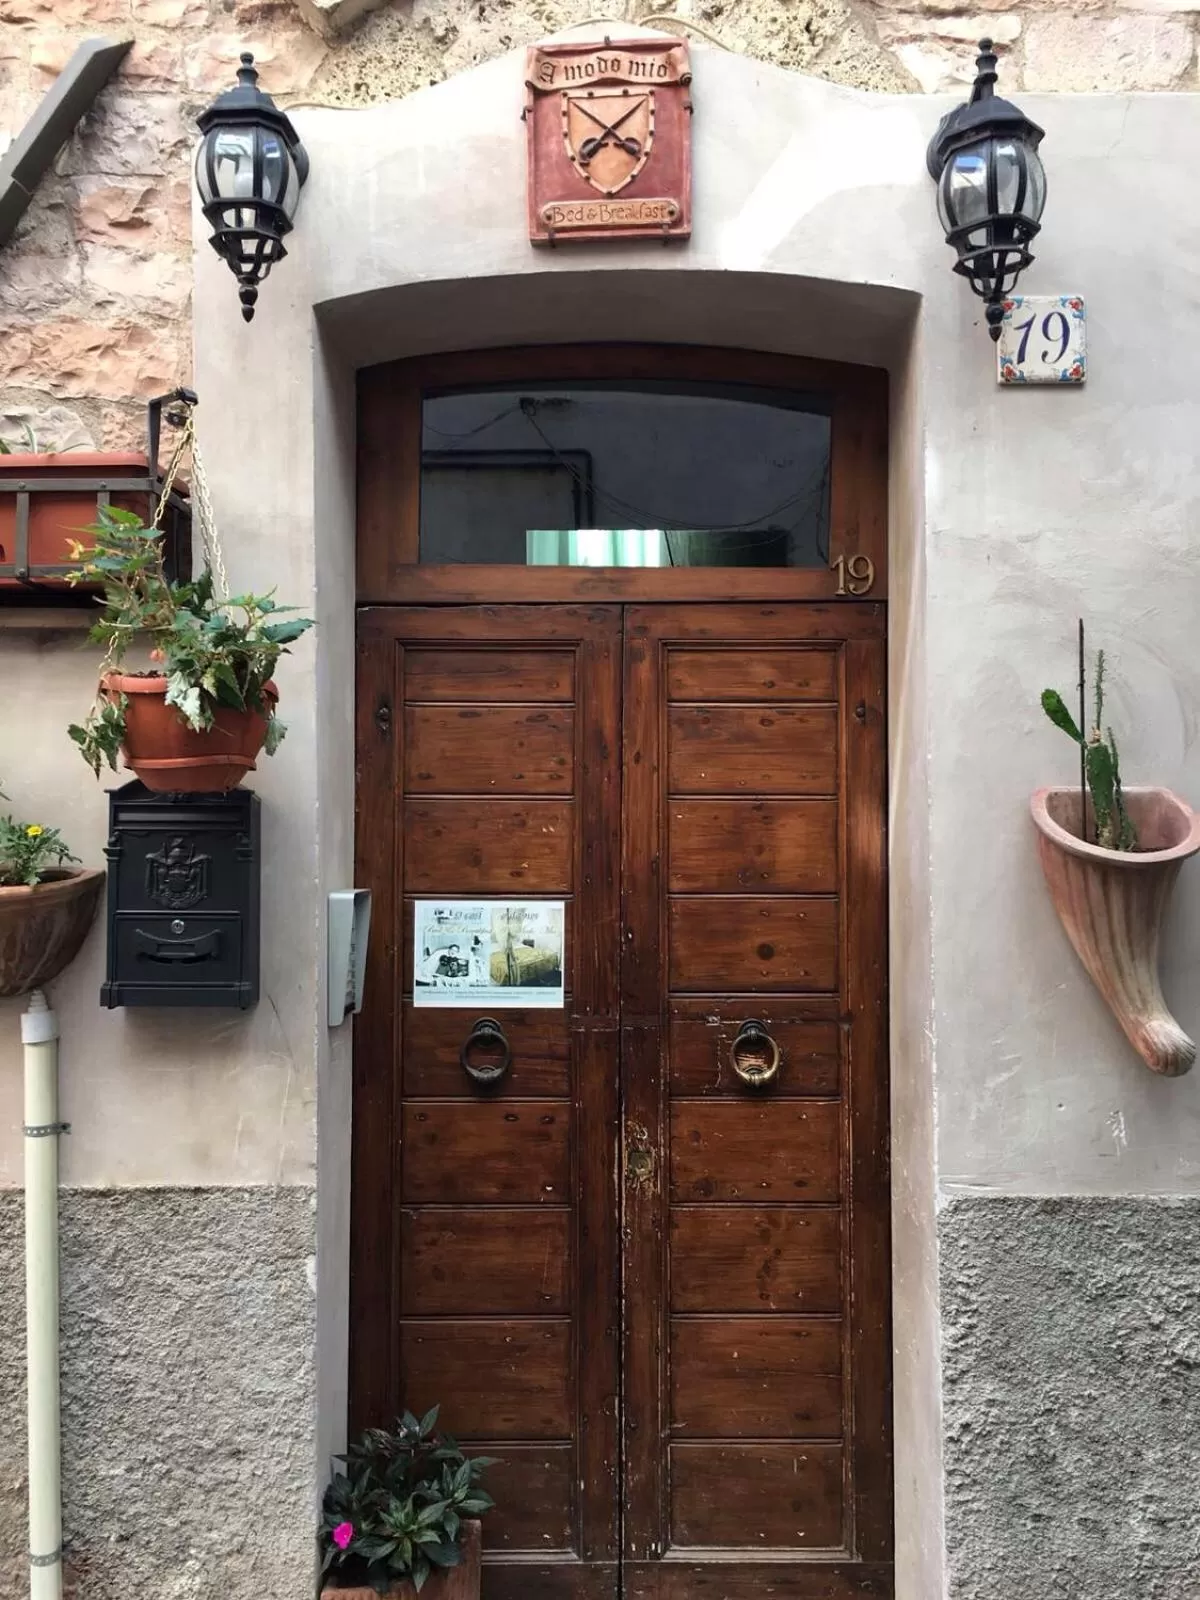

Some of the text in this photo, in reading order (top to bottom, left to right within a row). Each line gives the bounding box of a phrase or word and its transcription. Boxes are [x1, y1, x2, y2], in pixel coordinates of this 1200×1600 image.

[539, 56, 670, 85] A modo mio
[553, 206, 584, 224] Bed
[599, 202, 668, 223] Breakfast
[1013, 311, 1071, 365] 19
[831, 554, 874, 595] 19
